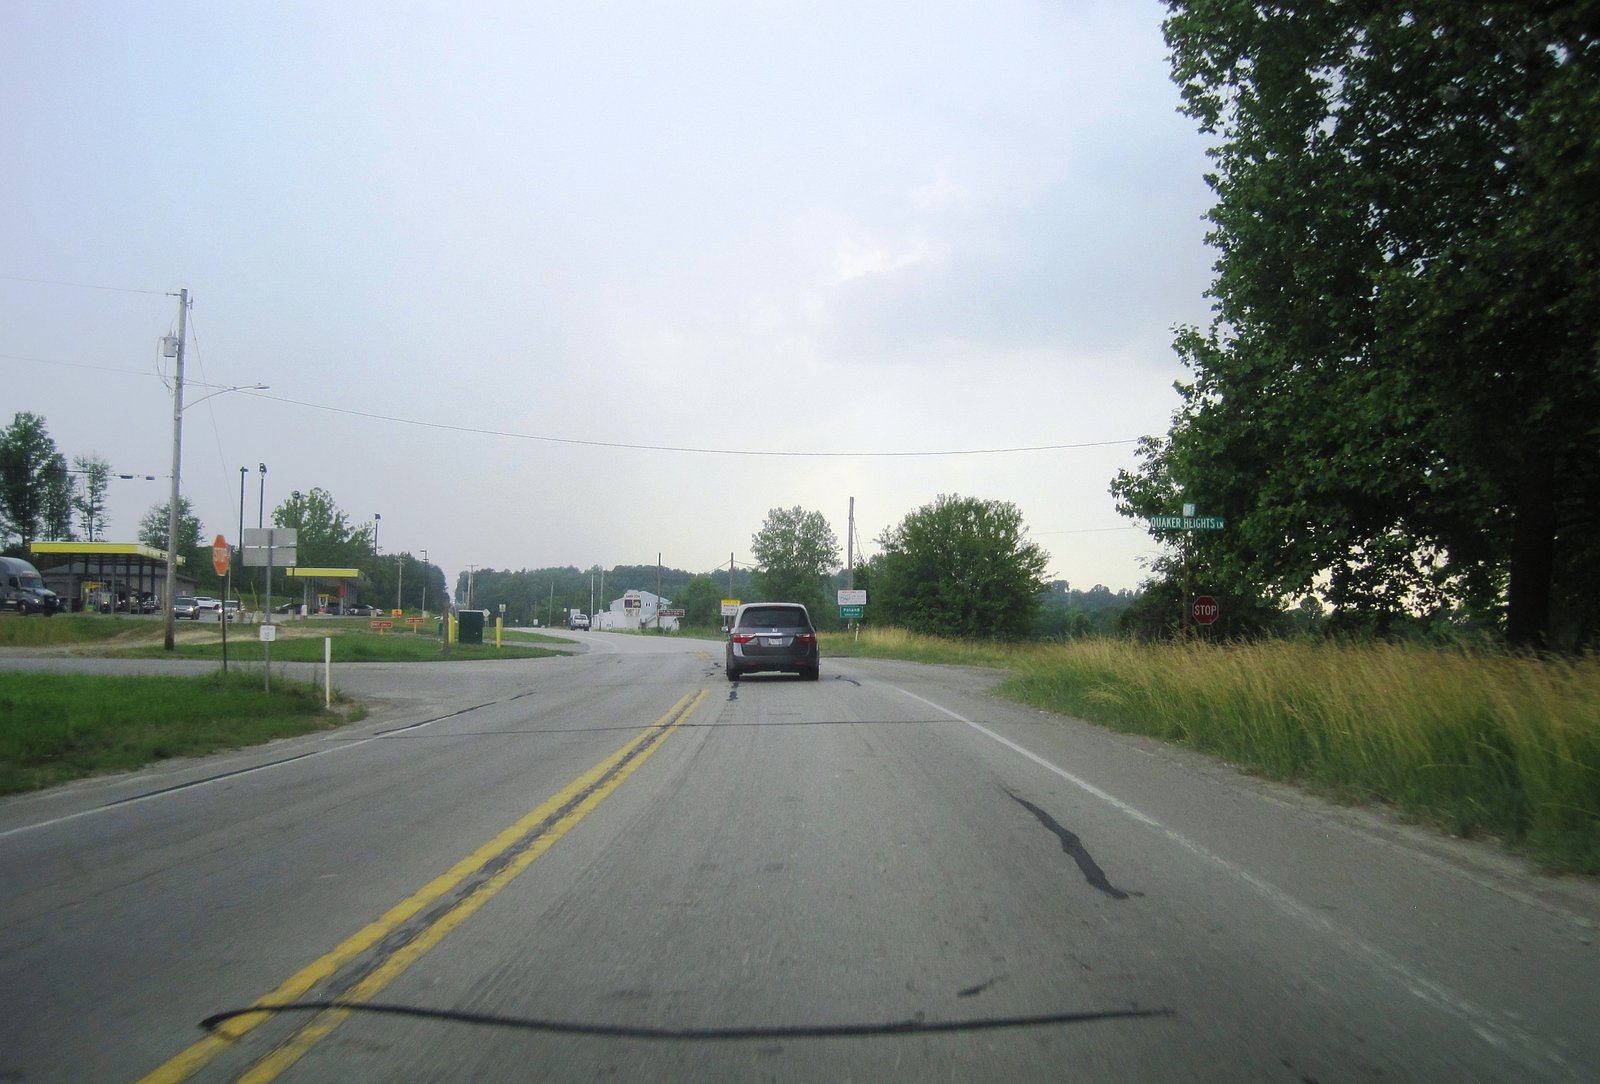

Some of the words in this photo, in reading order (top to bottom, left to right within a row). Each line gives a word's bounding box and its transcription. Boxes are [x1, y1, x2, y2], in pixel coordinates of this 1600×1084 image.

[1151, 517, 1181, 528] QUAKER
[1184, 518, 1215, 529] HEIGHTS
[1195, 605, 1216, 616] STOP
